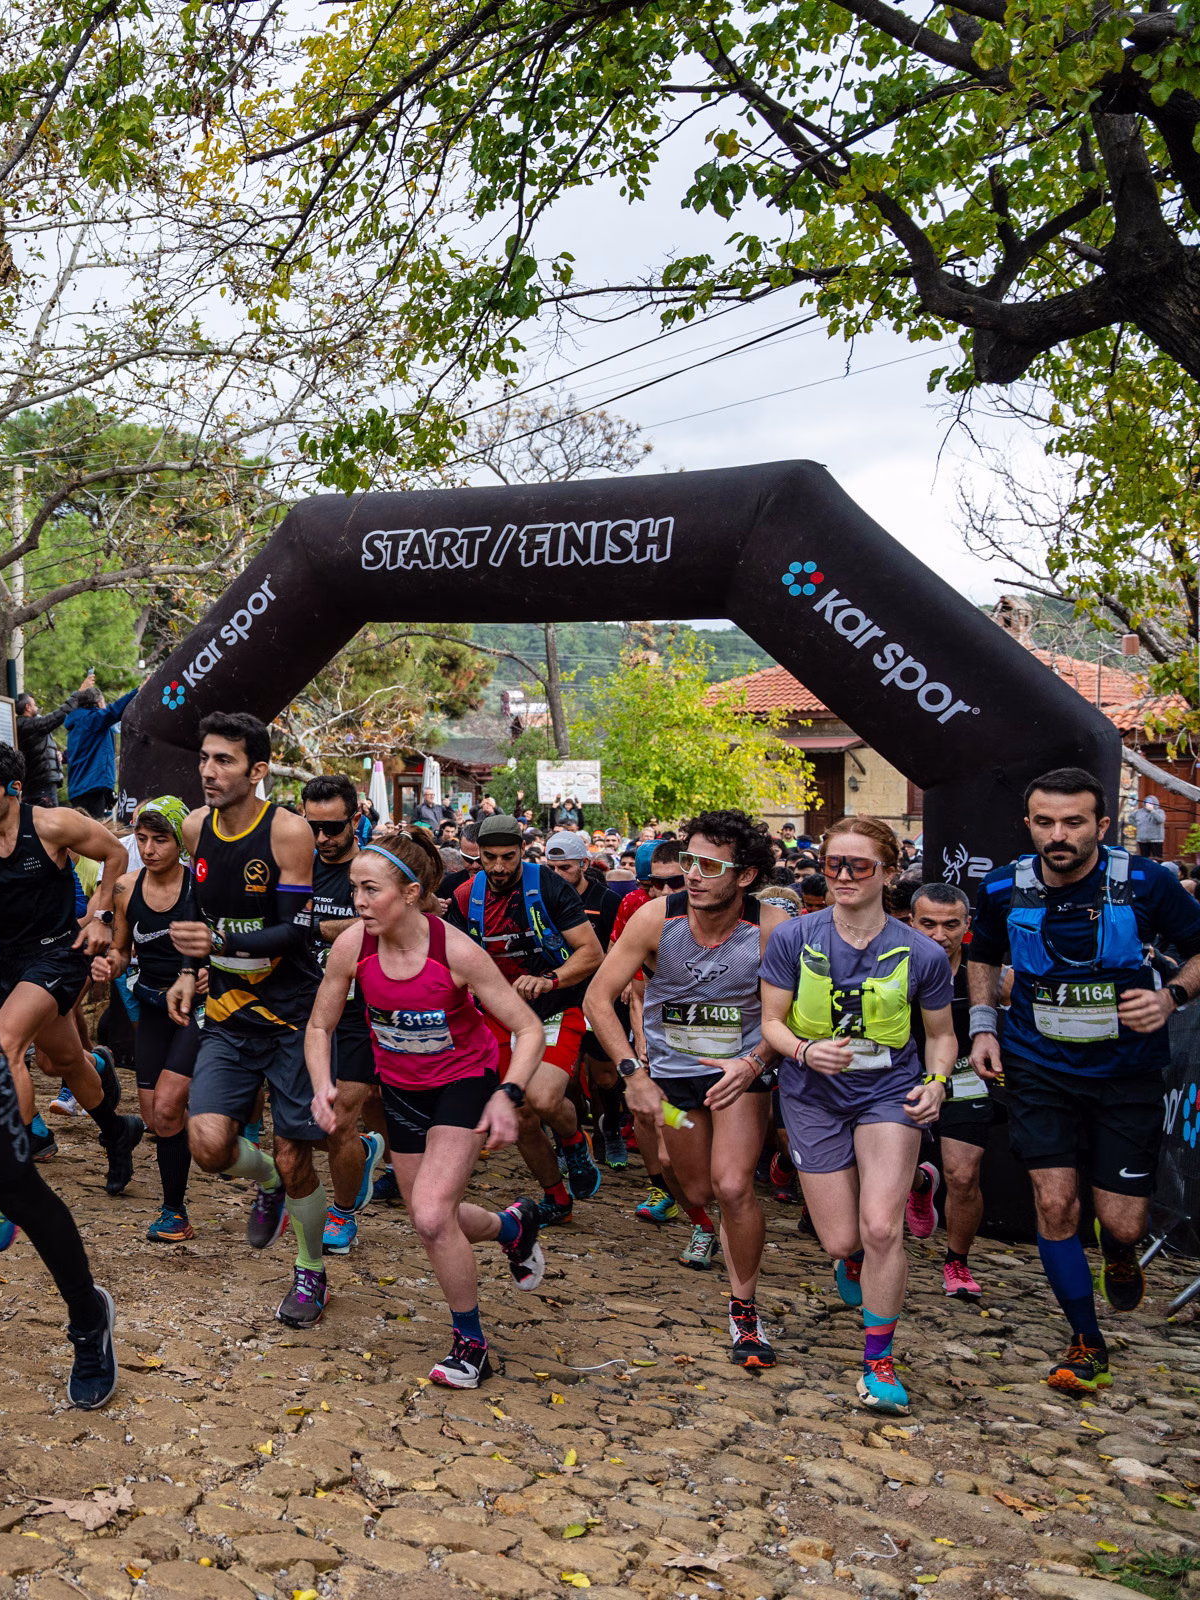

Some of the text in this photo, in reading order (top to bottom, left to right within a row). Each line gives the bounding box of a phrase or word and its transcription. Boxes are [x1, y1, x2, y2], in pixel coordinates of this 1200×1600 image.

[362, 526, 491, 571] START
[518, 516, 675, 568] FINISH
[812, 588, 887, 650] kar
[182, 638, 223, 688] kar
[228, 920, 262, 934] 1168
[1072, 985, 1115, 1002] 1164
[402, 1012, 444, 1027] 3133
[700, 1006, 740, 1022] 1403
